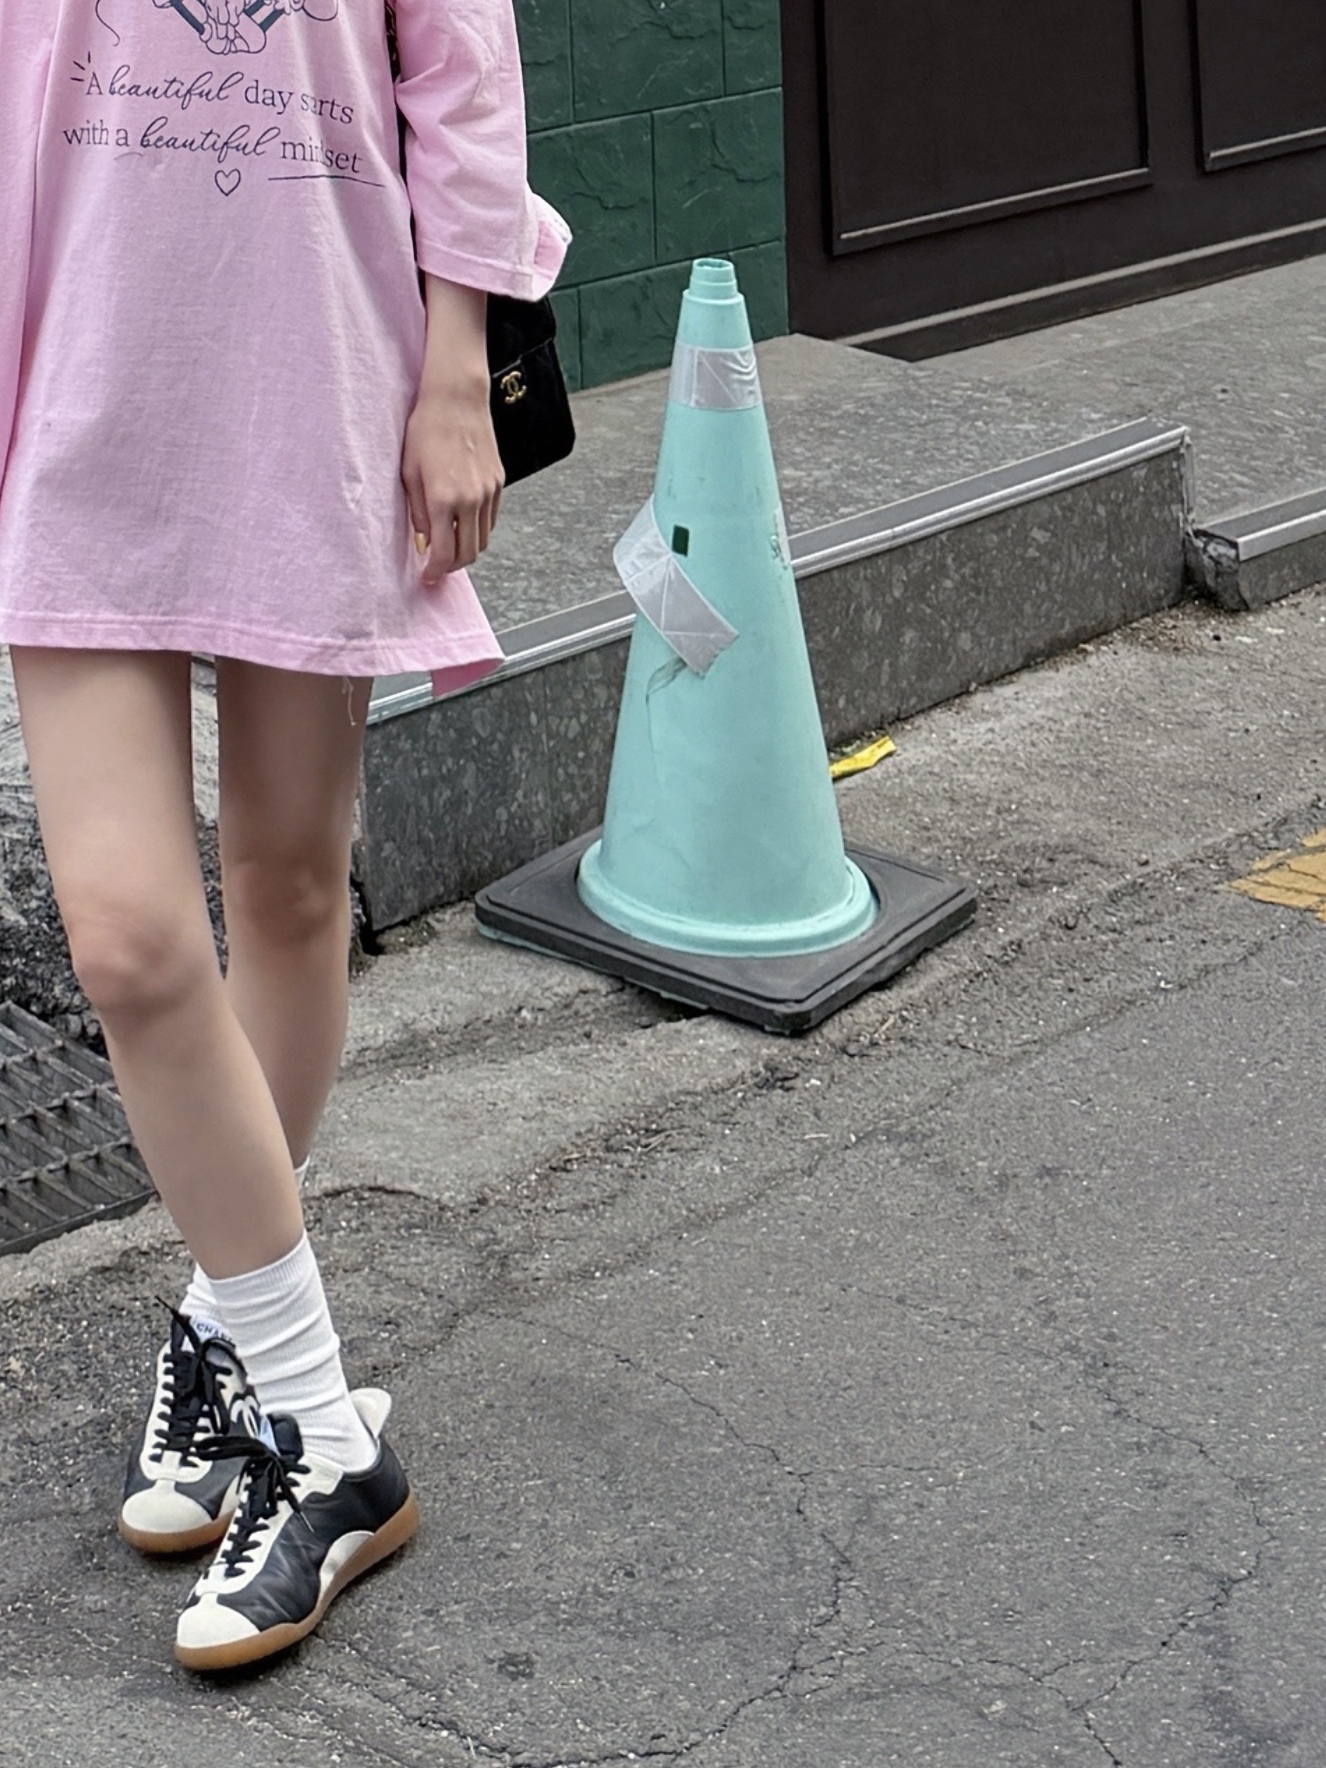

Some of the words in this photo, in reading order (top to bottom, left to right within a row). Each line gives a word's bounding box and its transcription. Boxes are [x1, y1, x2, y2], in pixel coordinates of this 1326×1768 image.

[86, 71, 103, 96] A
[108, 64, 244, 110] beautiful
[244, 79, 295, 115] day
[300, 93, 354, 124] srts
[63, 119, 109, 146] with
[115, 128, 129, 148] a
[139, 116, 281, 164] beautiful
